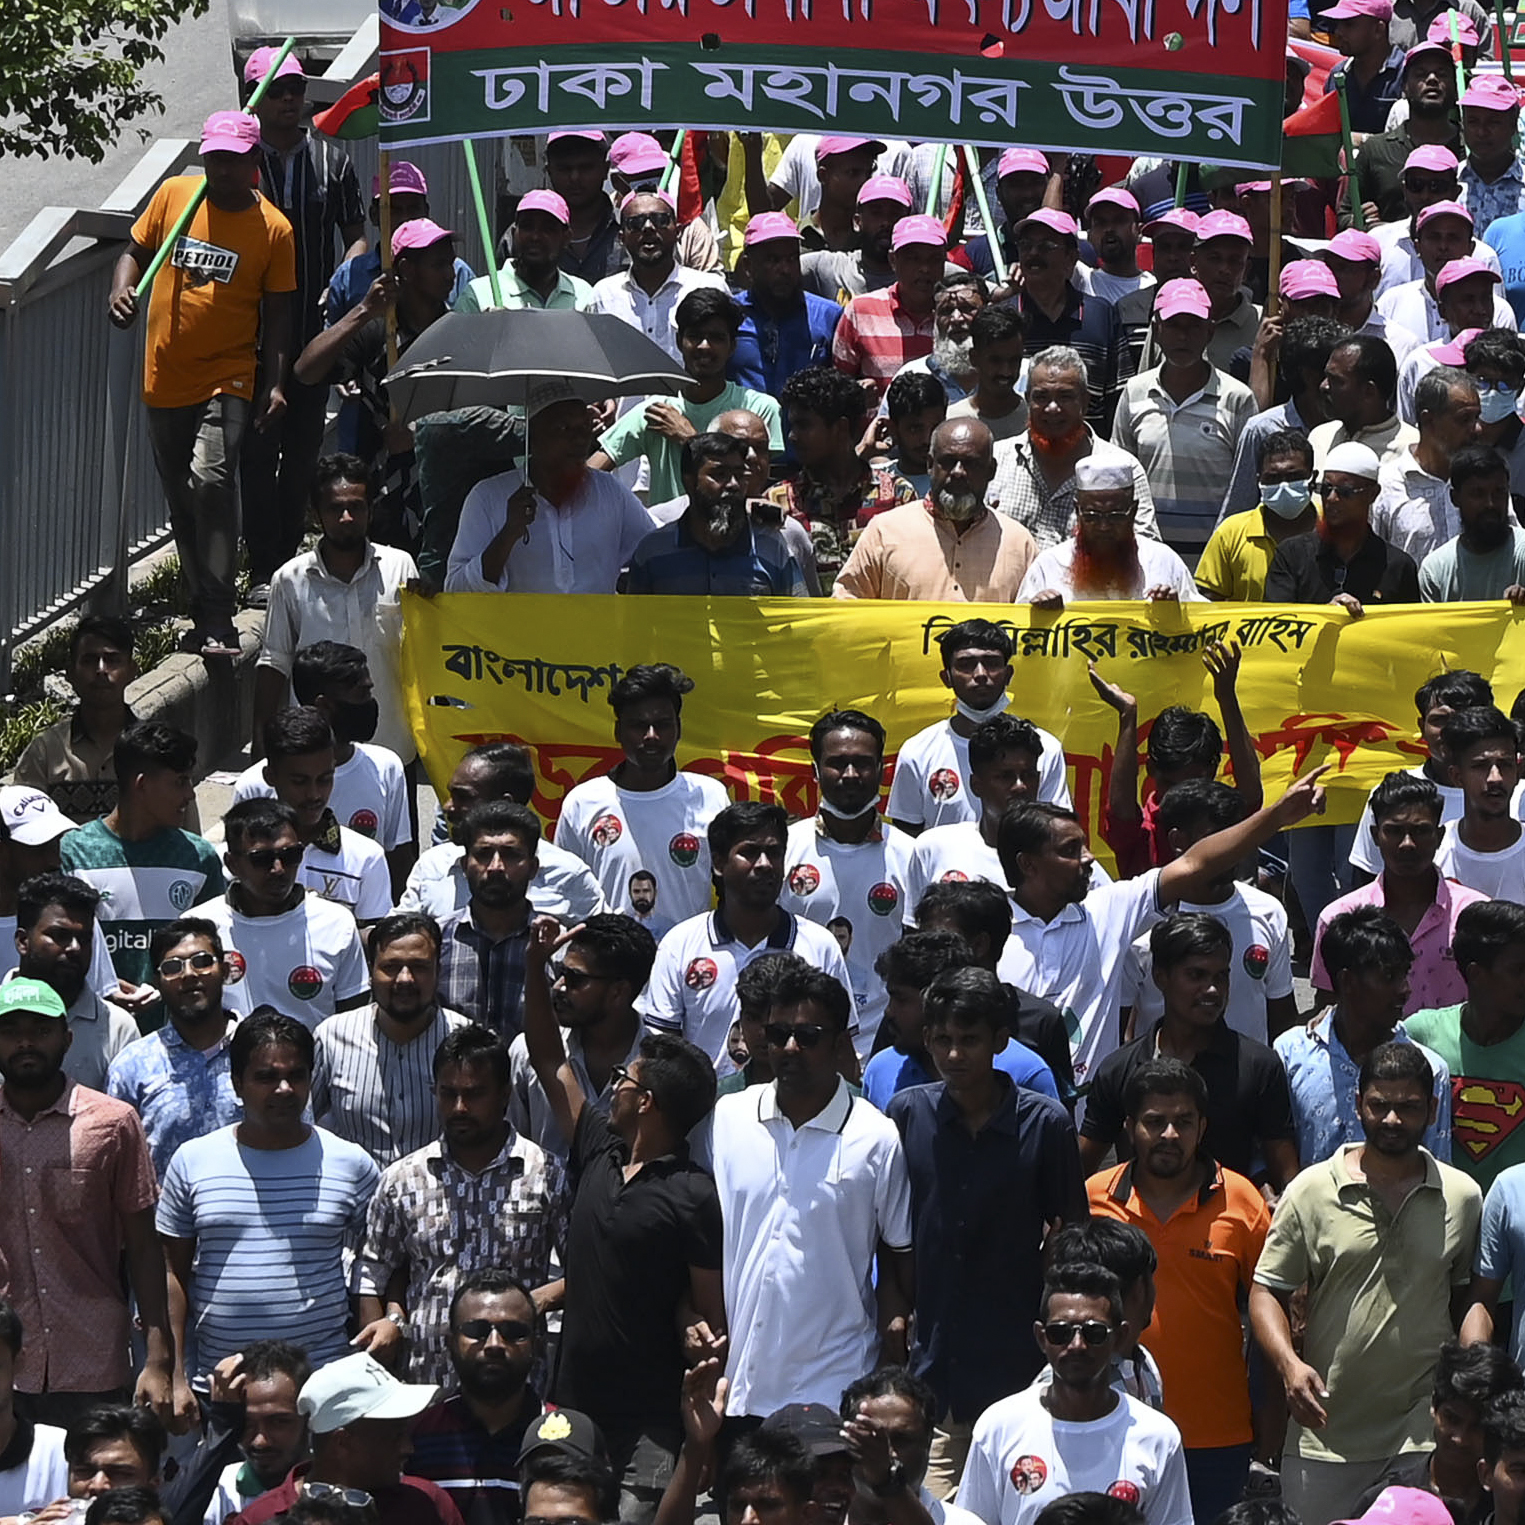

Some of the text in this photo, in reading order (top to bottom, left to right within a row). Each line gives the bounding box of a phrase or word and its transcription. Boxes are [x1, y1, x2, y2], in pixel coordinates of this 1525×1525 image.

[470, 56, 1257, 147] ঢাকা মহানগর উত্তর
[174, 250, 236, 269] PETROL
[442, 643, 621, 704] বাংলাদেশ
[104, 929, 152, 954] gital
